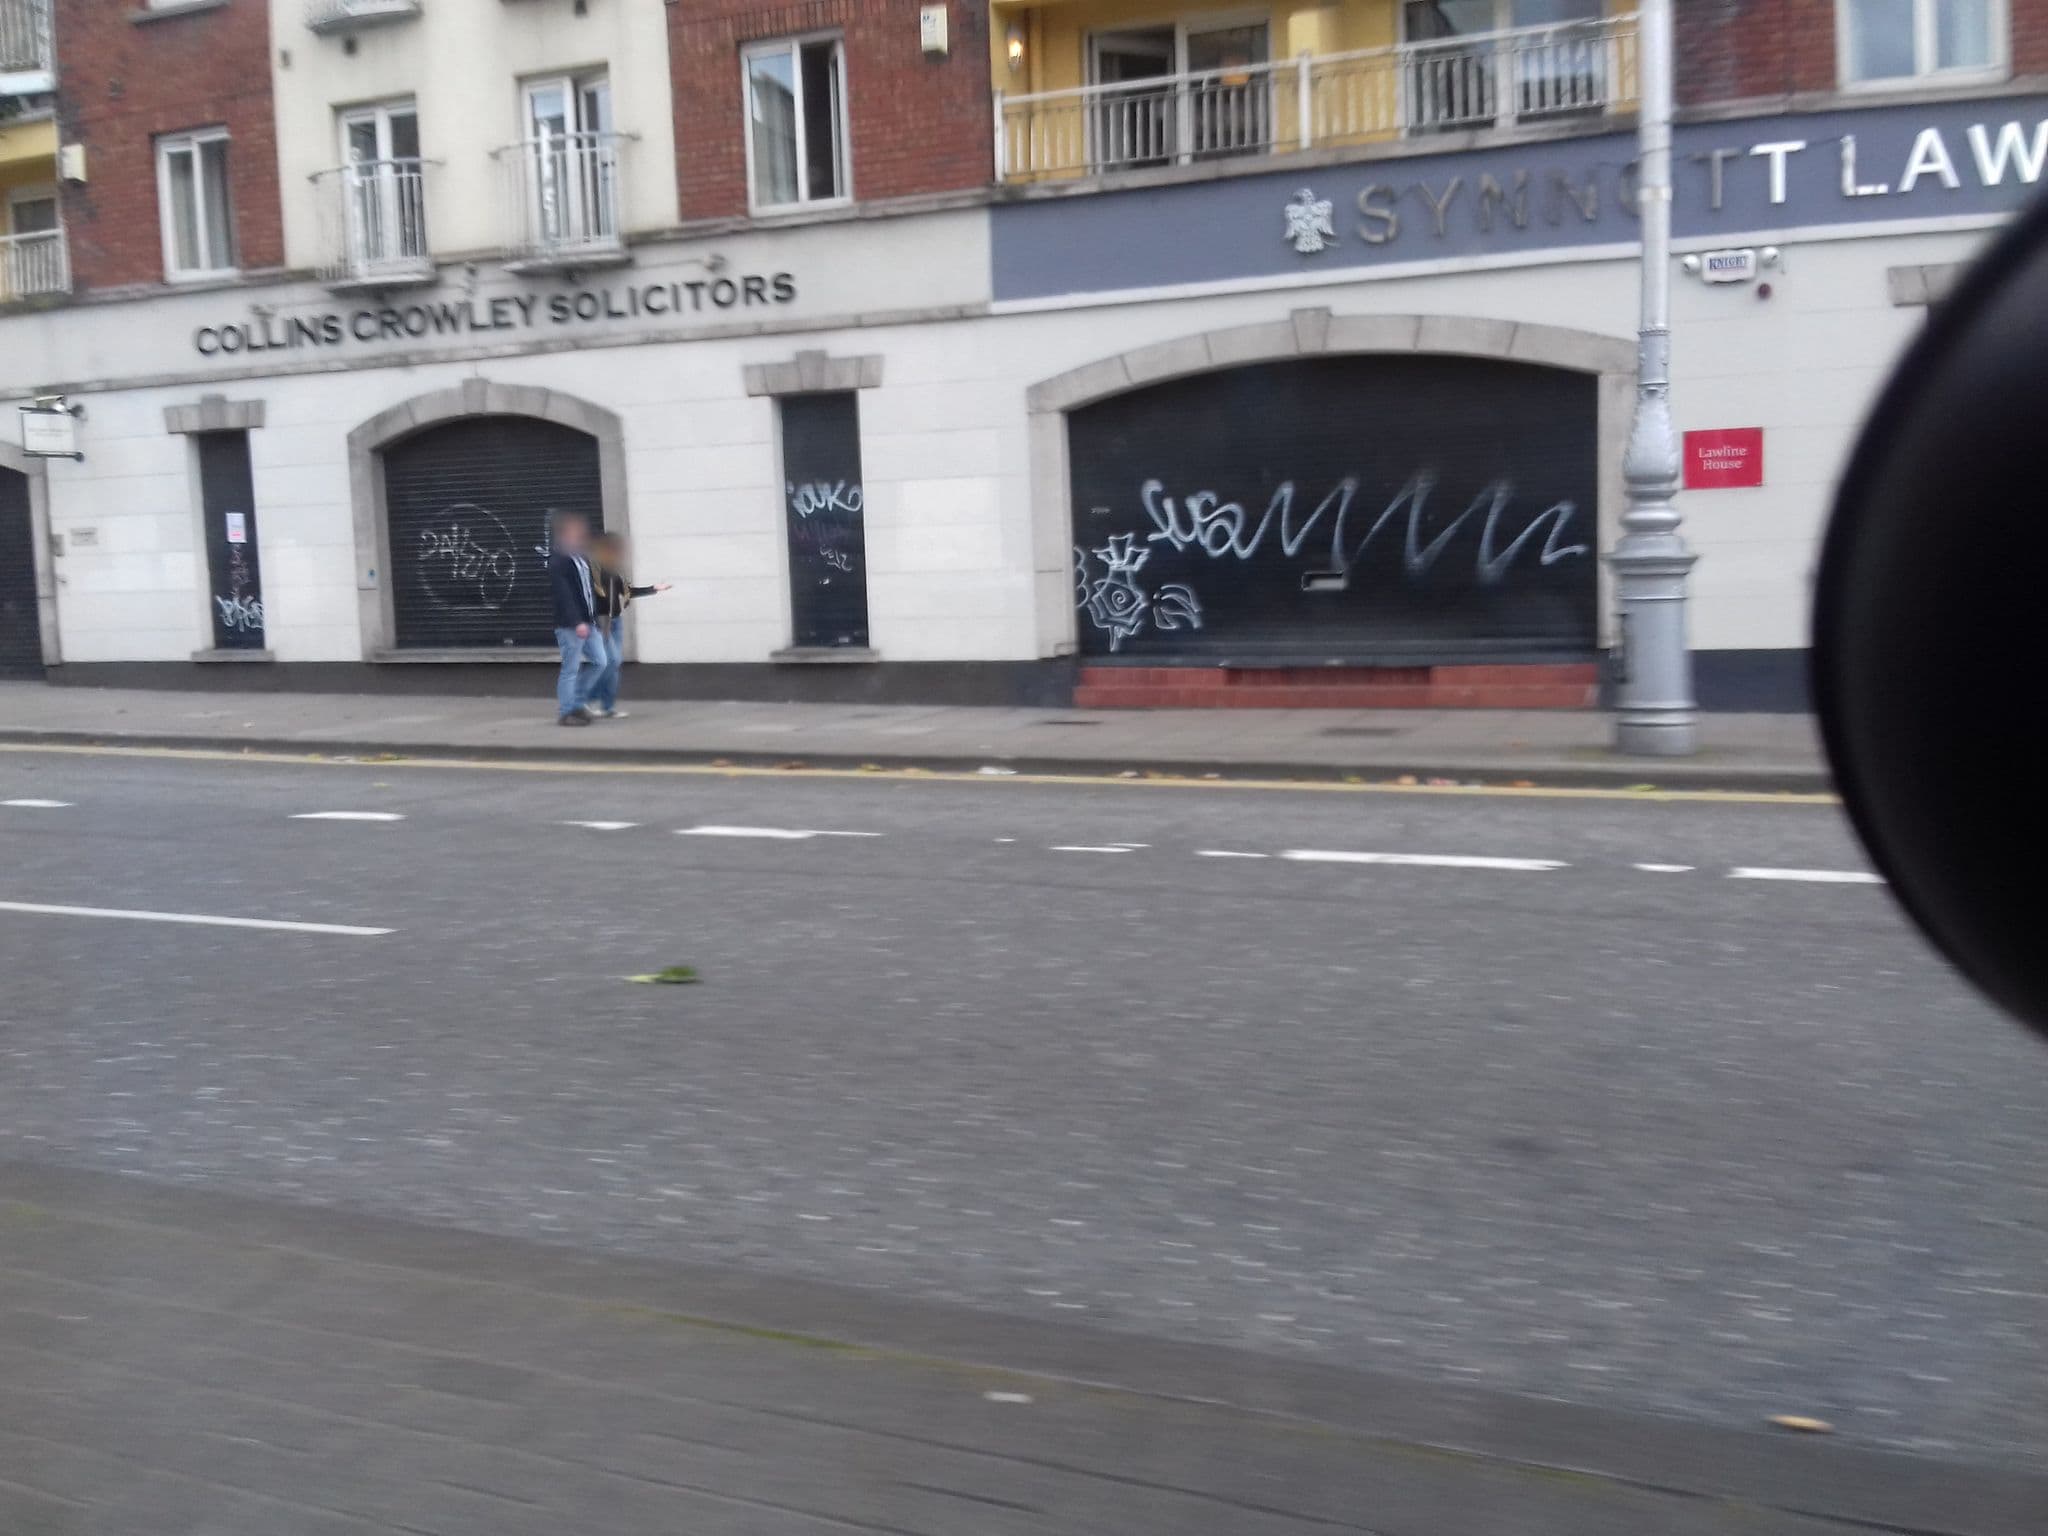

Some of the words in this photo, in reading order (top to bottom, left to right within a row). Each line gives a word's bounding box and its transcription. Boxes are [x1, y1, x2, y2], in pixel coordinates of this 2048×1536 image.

[1840, 118, 2048, 198] LAW
[196, 314, 342, 356] COLLINS
[352, 293, 538, 341] CROWLEY
[549, 271, 797, 324] SOLICITORS
[1698, 445, 1748, 459] Lawline
[1703, 459, 1743, 471] House
